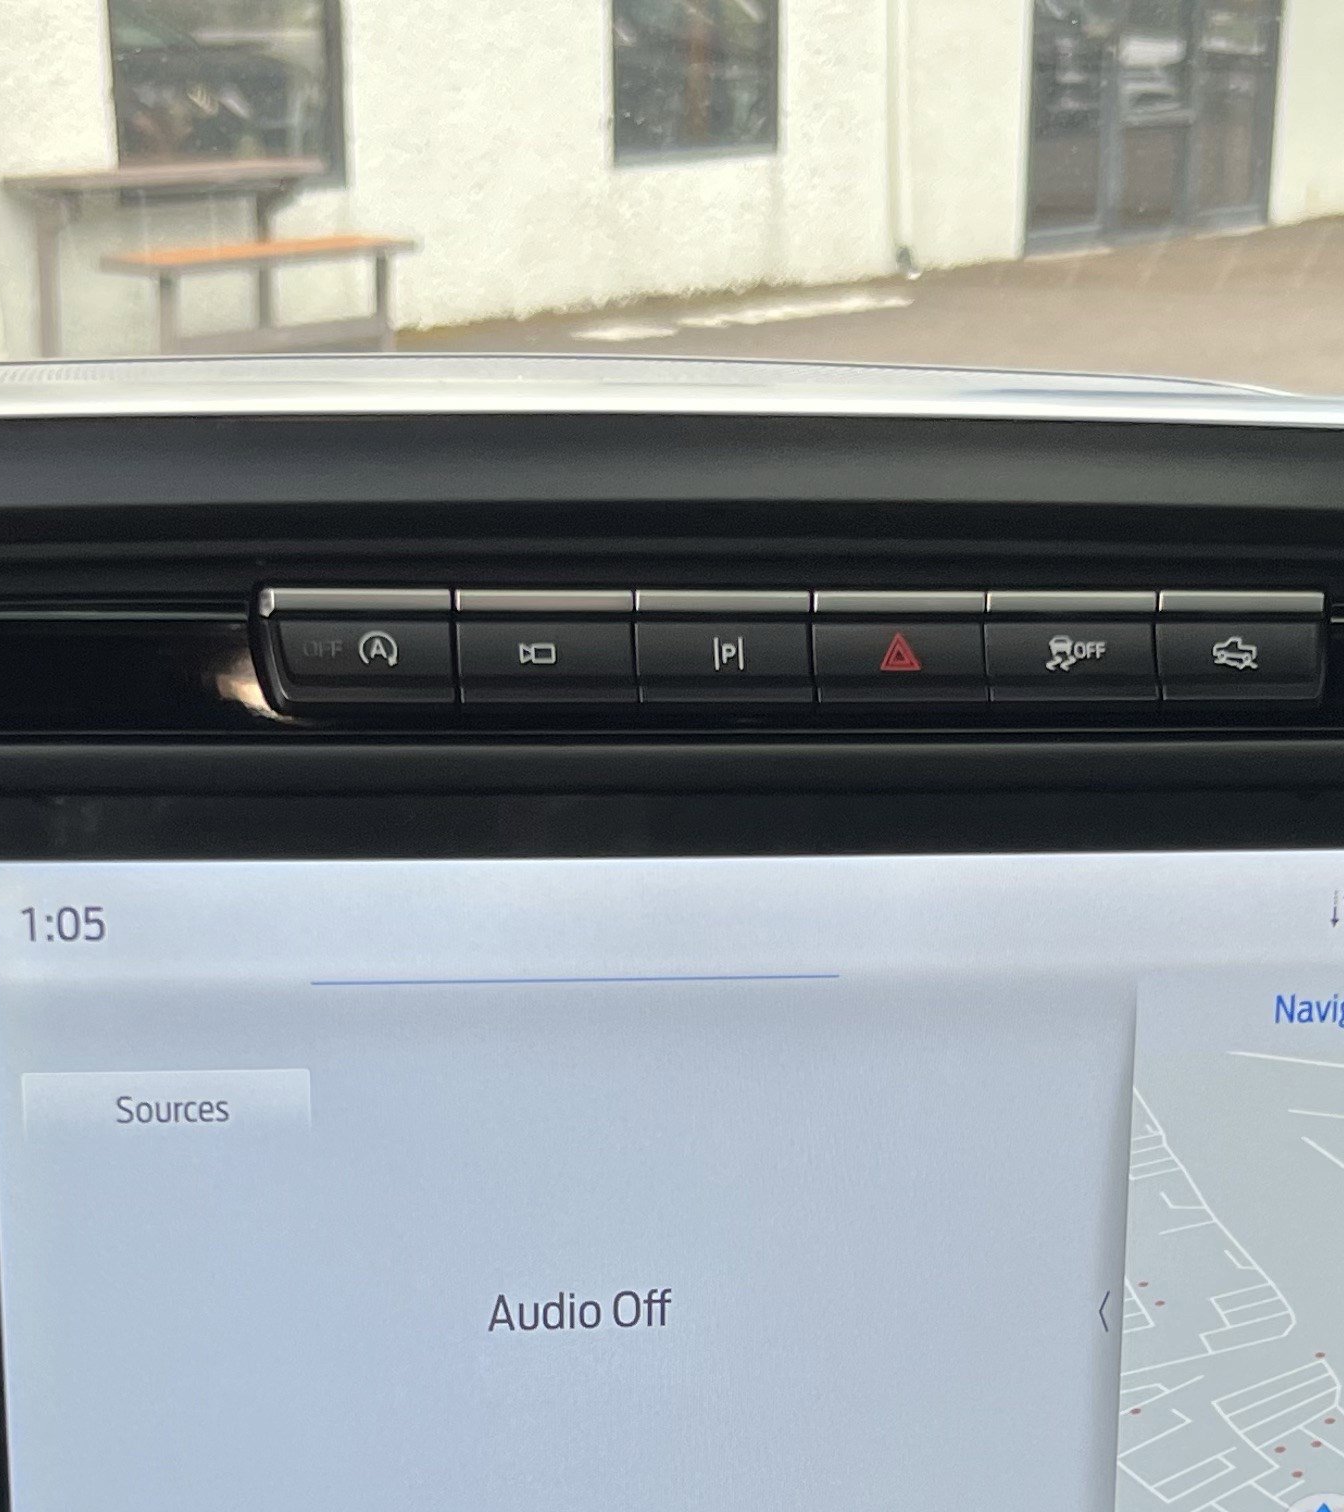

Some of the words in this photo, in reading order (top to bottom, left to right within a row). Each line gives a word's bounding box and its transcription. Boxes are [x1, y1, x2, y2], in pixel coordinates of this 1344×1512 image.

[1073, 641, 1106, 659] OFF
[20, 905, 106, 943] 1:05
[116, 1095, 230, 1124] Sources
[488, 1291, 602, 1332] Audio
[612, 1288, 673, 1328] Off
